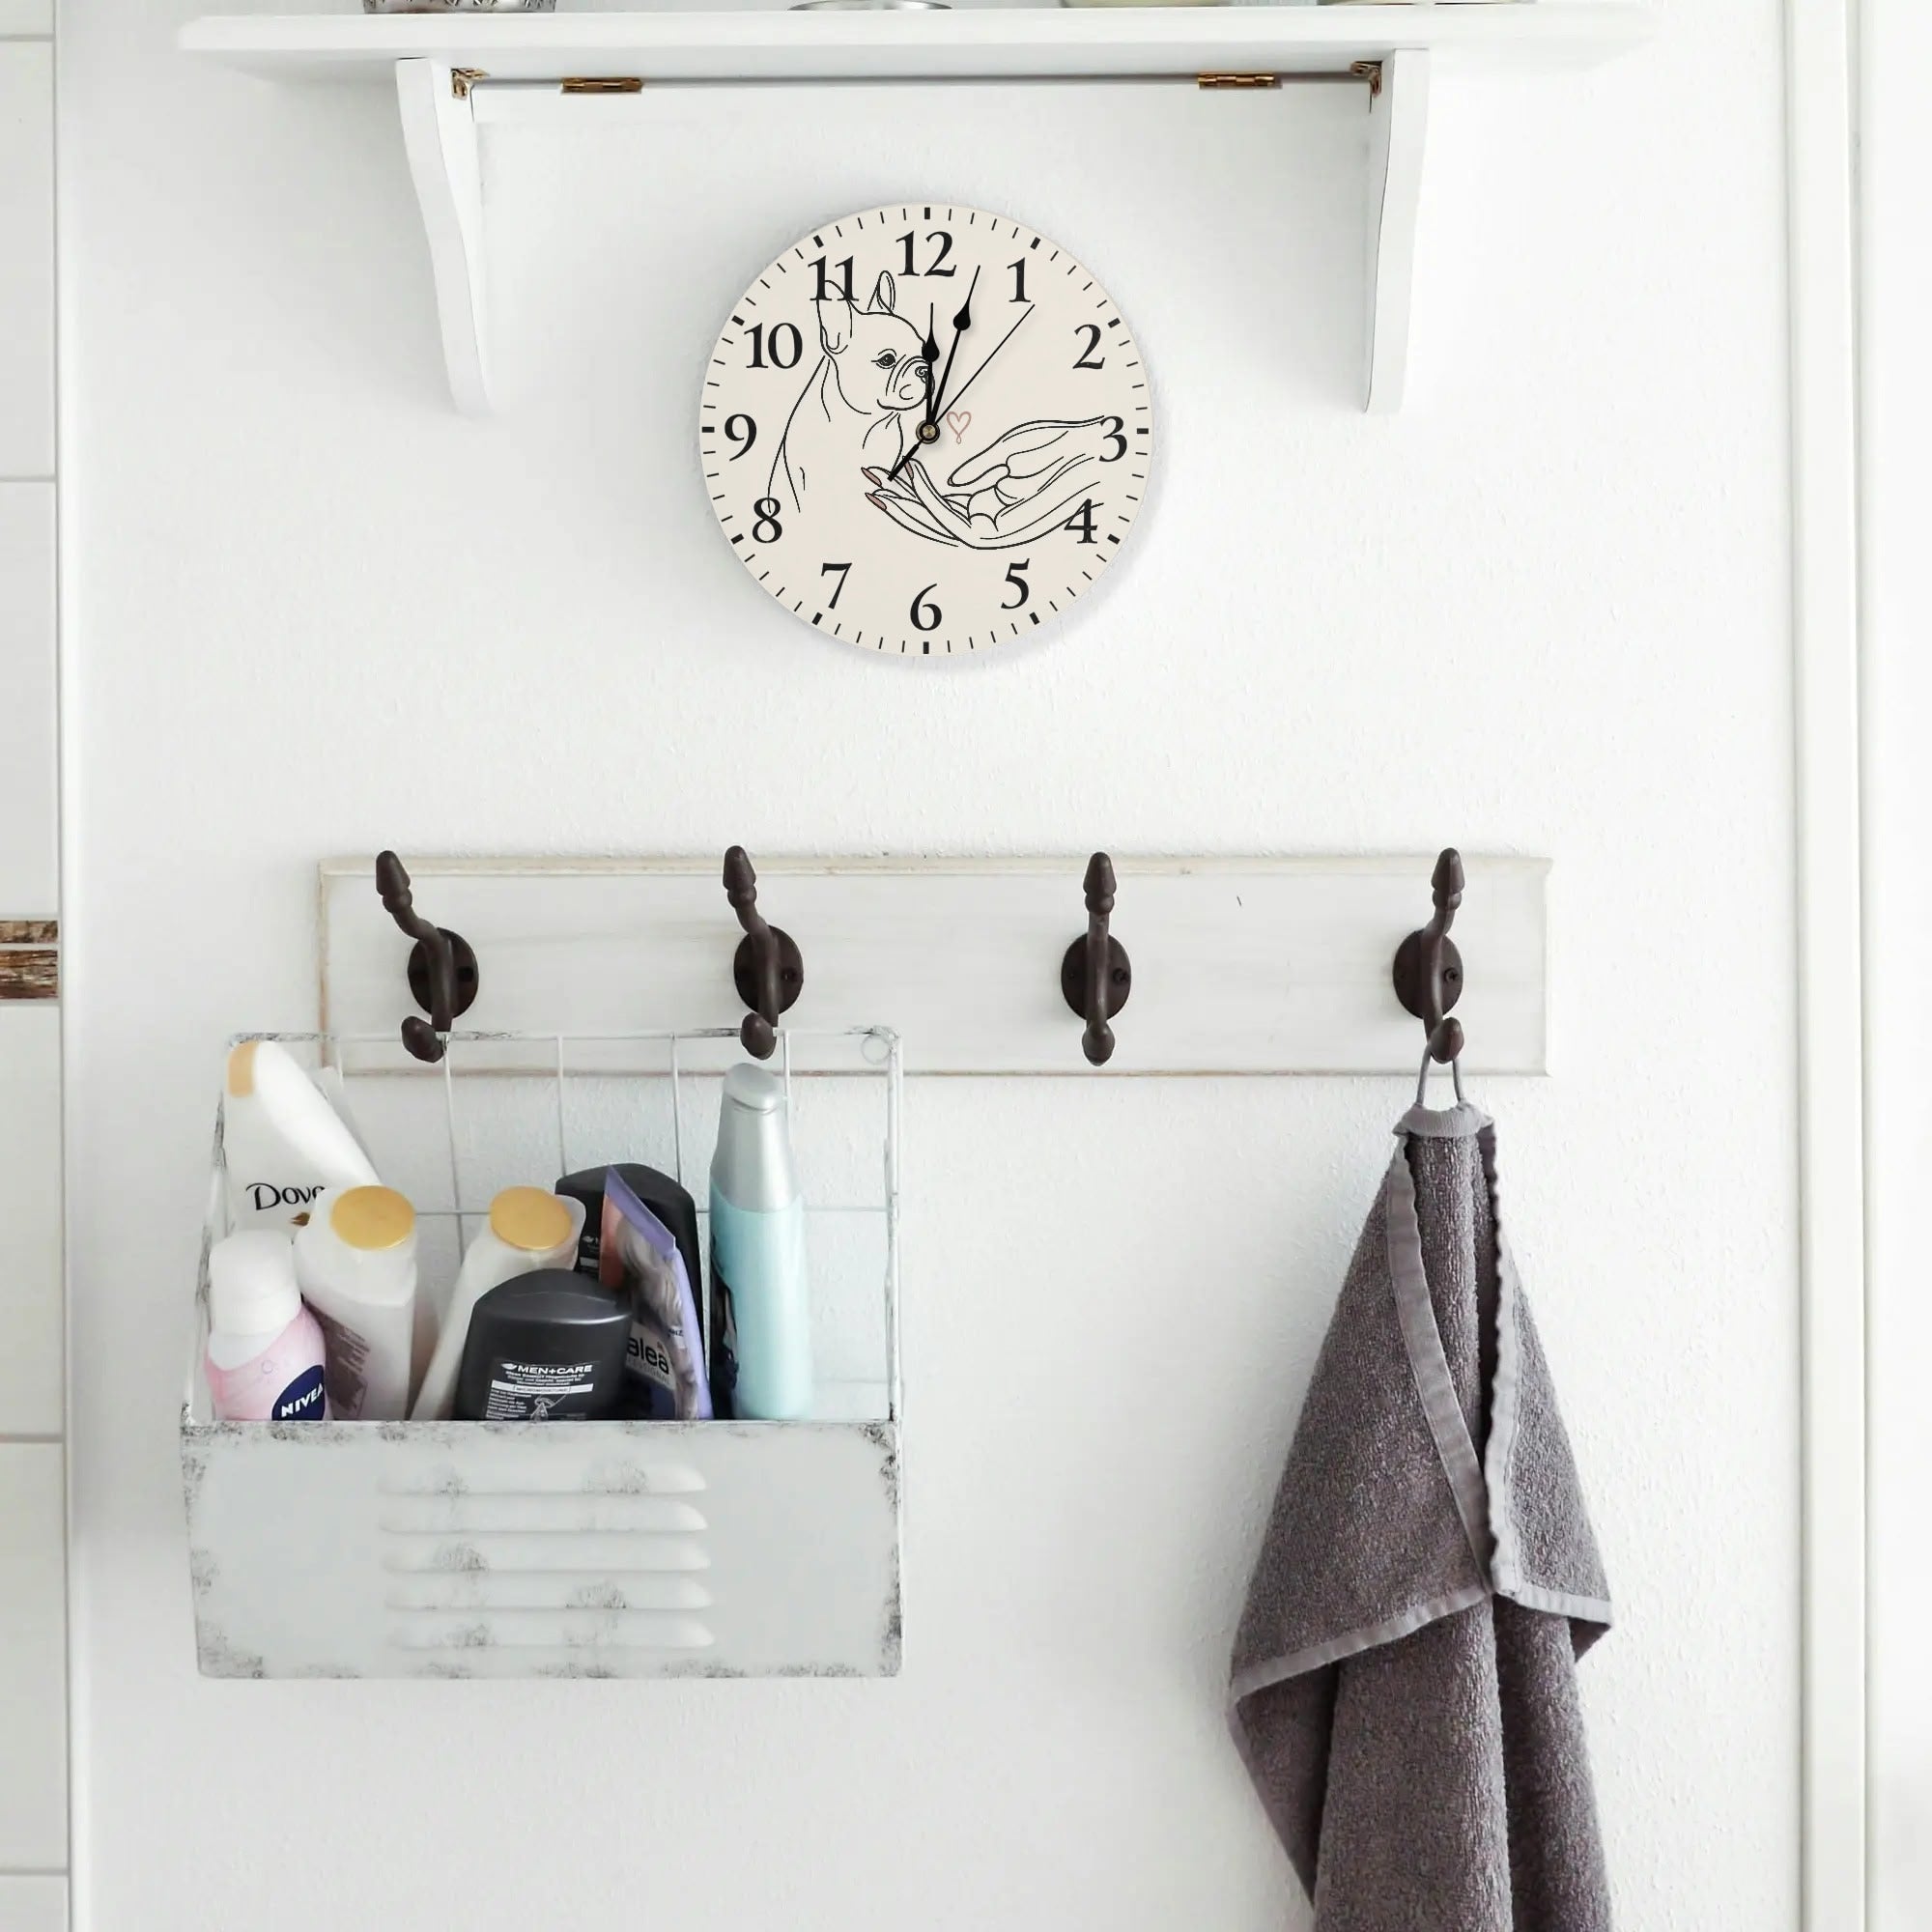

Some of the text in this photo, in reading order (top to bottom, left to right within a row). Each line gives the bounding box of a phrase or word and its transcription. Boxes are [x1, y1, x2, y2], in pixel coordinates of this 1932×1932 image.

[895, 230, 957, 277] 12
[808, 255, 860, 301] 11
[1007, 257, 1032, 302] 1
[744, 322, 803, 369] 10
[1072, 324, 1107, 370] 2
[724, 413, 757, 462] 9
[1098, 415, 1128, 462] 3
[752, 497, 783, 544] 8
[1064, 498, 1099, 544] 4
[820, 562, 853, 610] 7
[909, 582, 943, 631] 6
[1000, 557, 1031, 609] 5
[517, 1364, 593, 1376] MEN+CARE
[627, 1337, 669, 1375] alea
[281, 1382, 324, 1418] NIVEA
